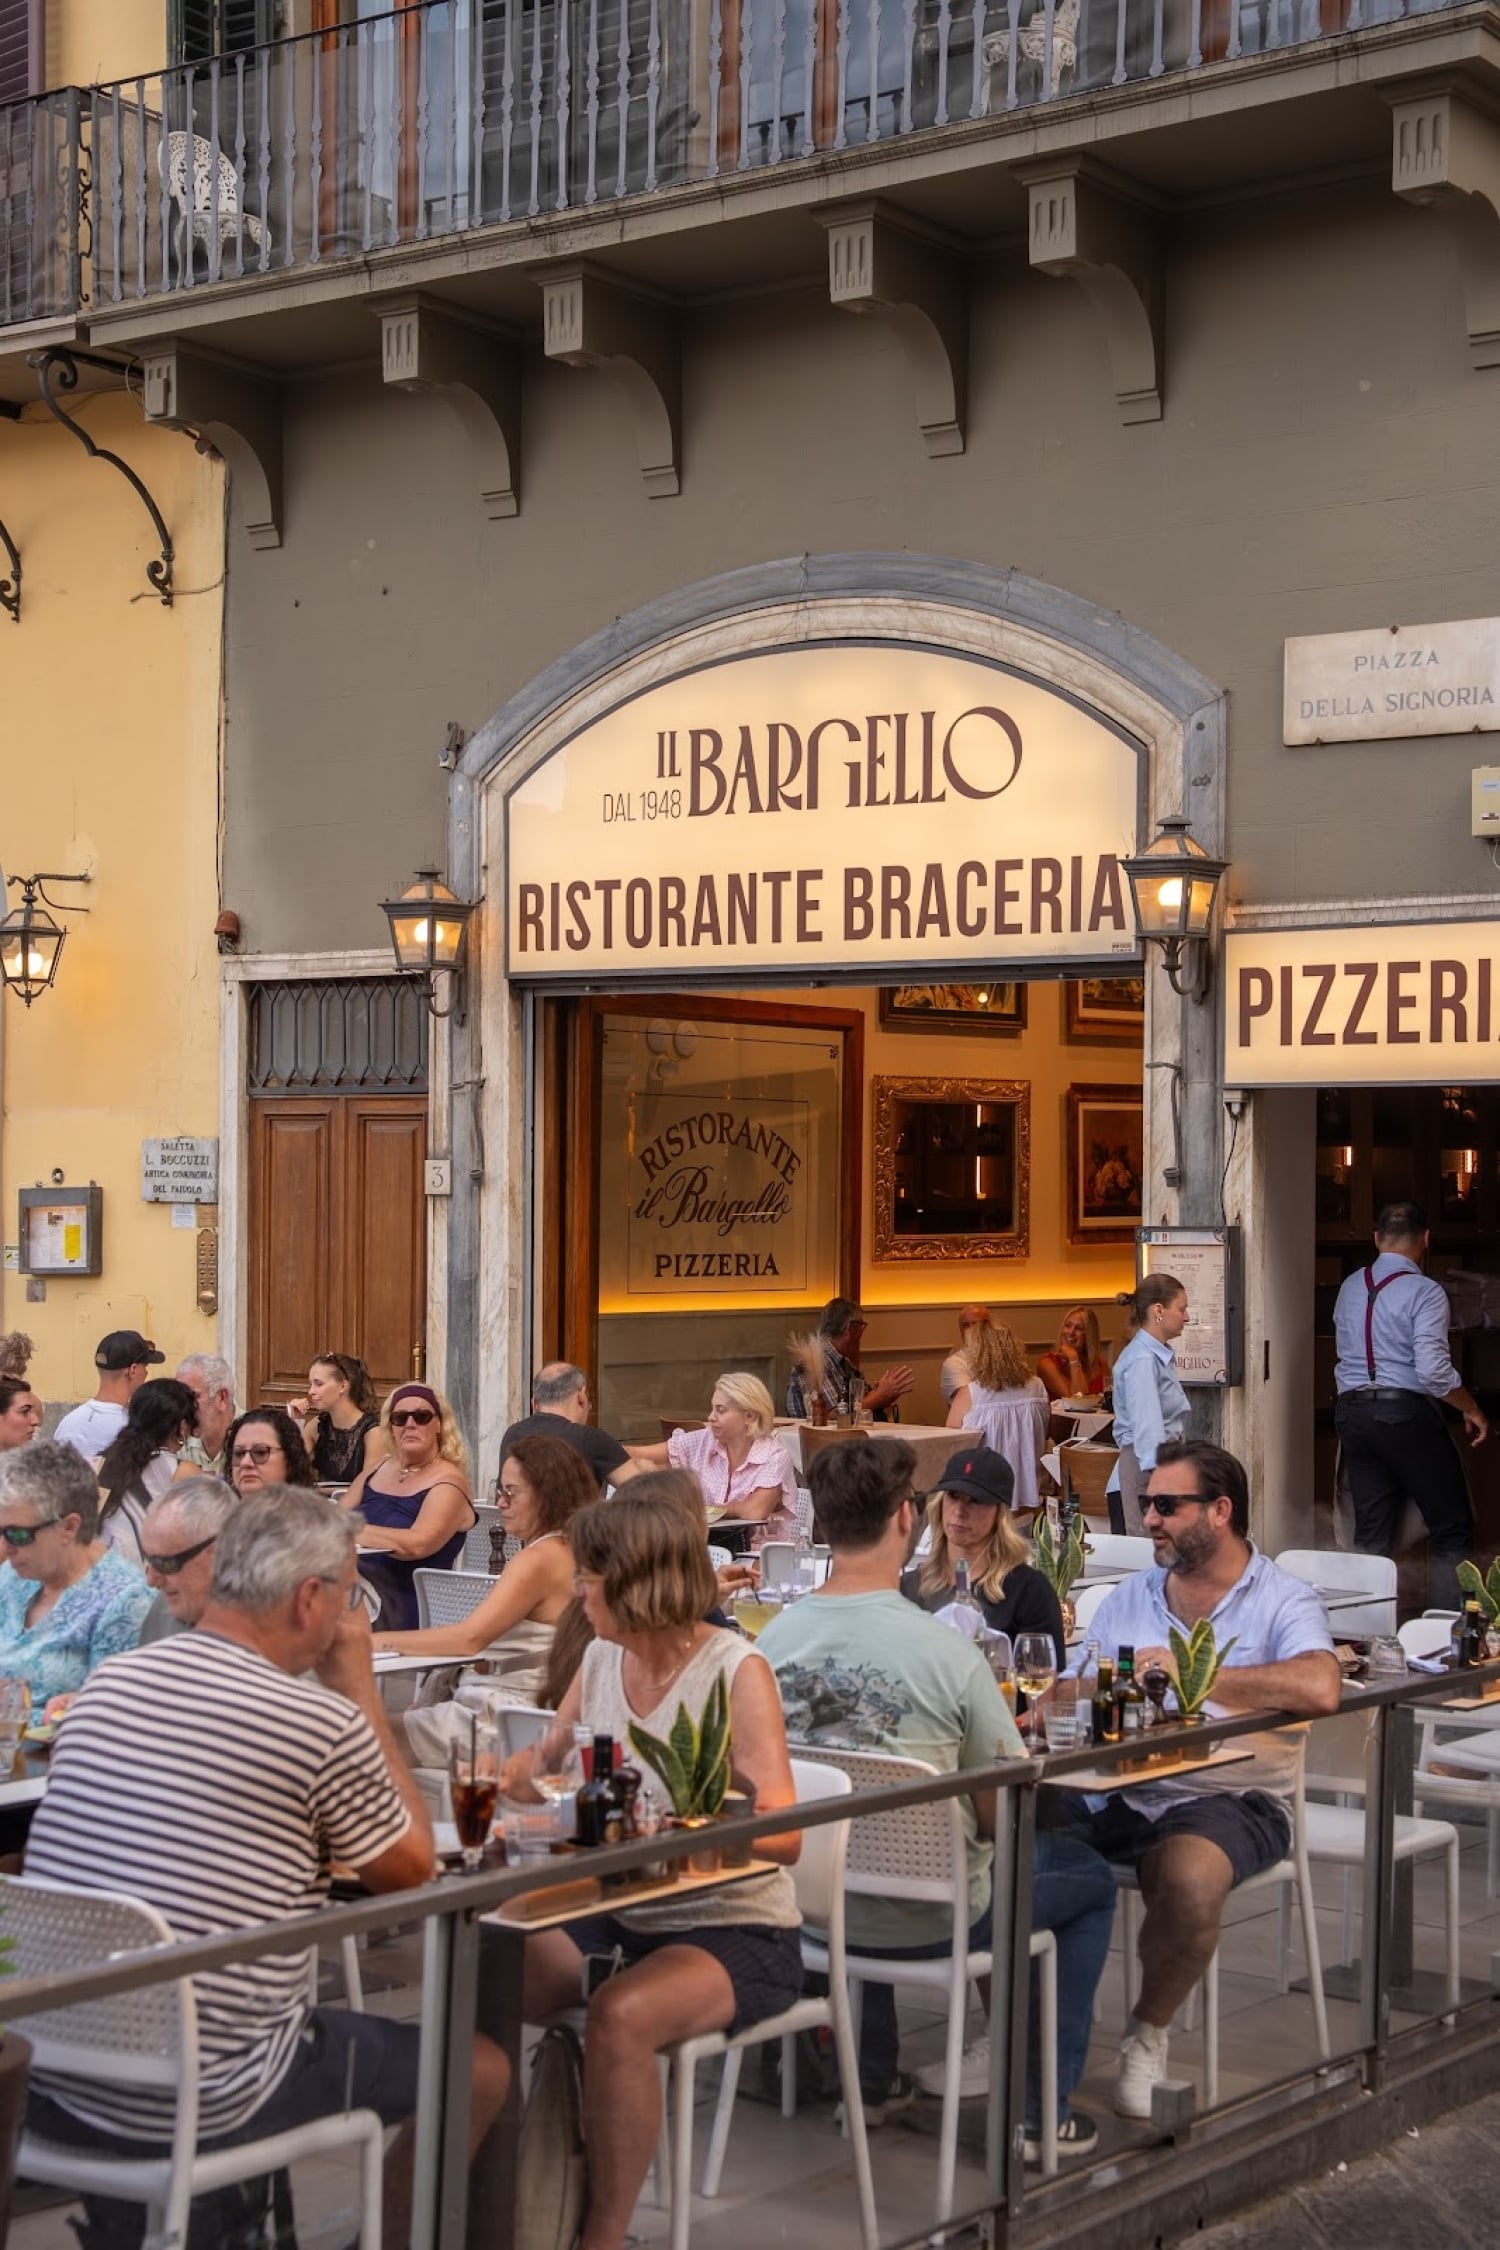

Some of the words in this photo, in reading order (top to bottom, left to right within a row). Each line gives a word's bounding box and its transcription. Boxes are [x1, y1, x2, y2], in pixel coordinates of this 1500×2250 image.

[1354, 650, 1440, 672] PIAZZA
[1300, 697, 1375, 719] DELLA
[1386, 686, 1495, 713] SIGNORIA
[656, 730, 682, 778] IL
[687, 706, 1023, 817] BARGELLO
[602, 792, 636, 823] DAL
[639, 789, 681, 820] 1948
[518, 868, 823, 953] RISTORANTE
[843, 853, 1127, 941] BRACERIA
[1239, 958, 1500, 1047] PIZZERI
[161, 1142, 195, 1152] SALETTA
[638, 1111, 801, 1185] RISTORANTE
[160, 1154, 210, 1166] BOCCUZZI
[144, 1169, 170, 1178] ANTICA
[431, 1166, 444, 1188] 3
[153, 1184, 167, 1193] DEL
[634, 1187, 663, 1219] il
[658, 1165, 793, 1237] Bargello
[654, 1253, 780, 1278] PIZZERIA
[1173, 1356, 1211, 1369] ARGELLO
